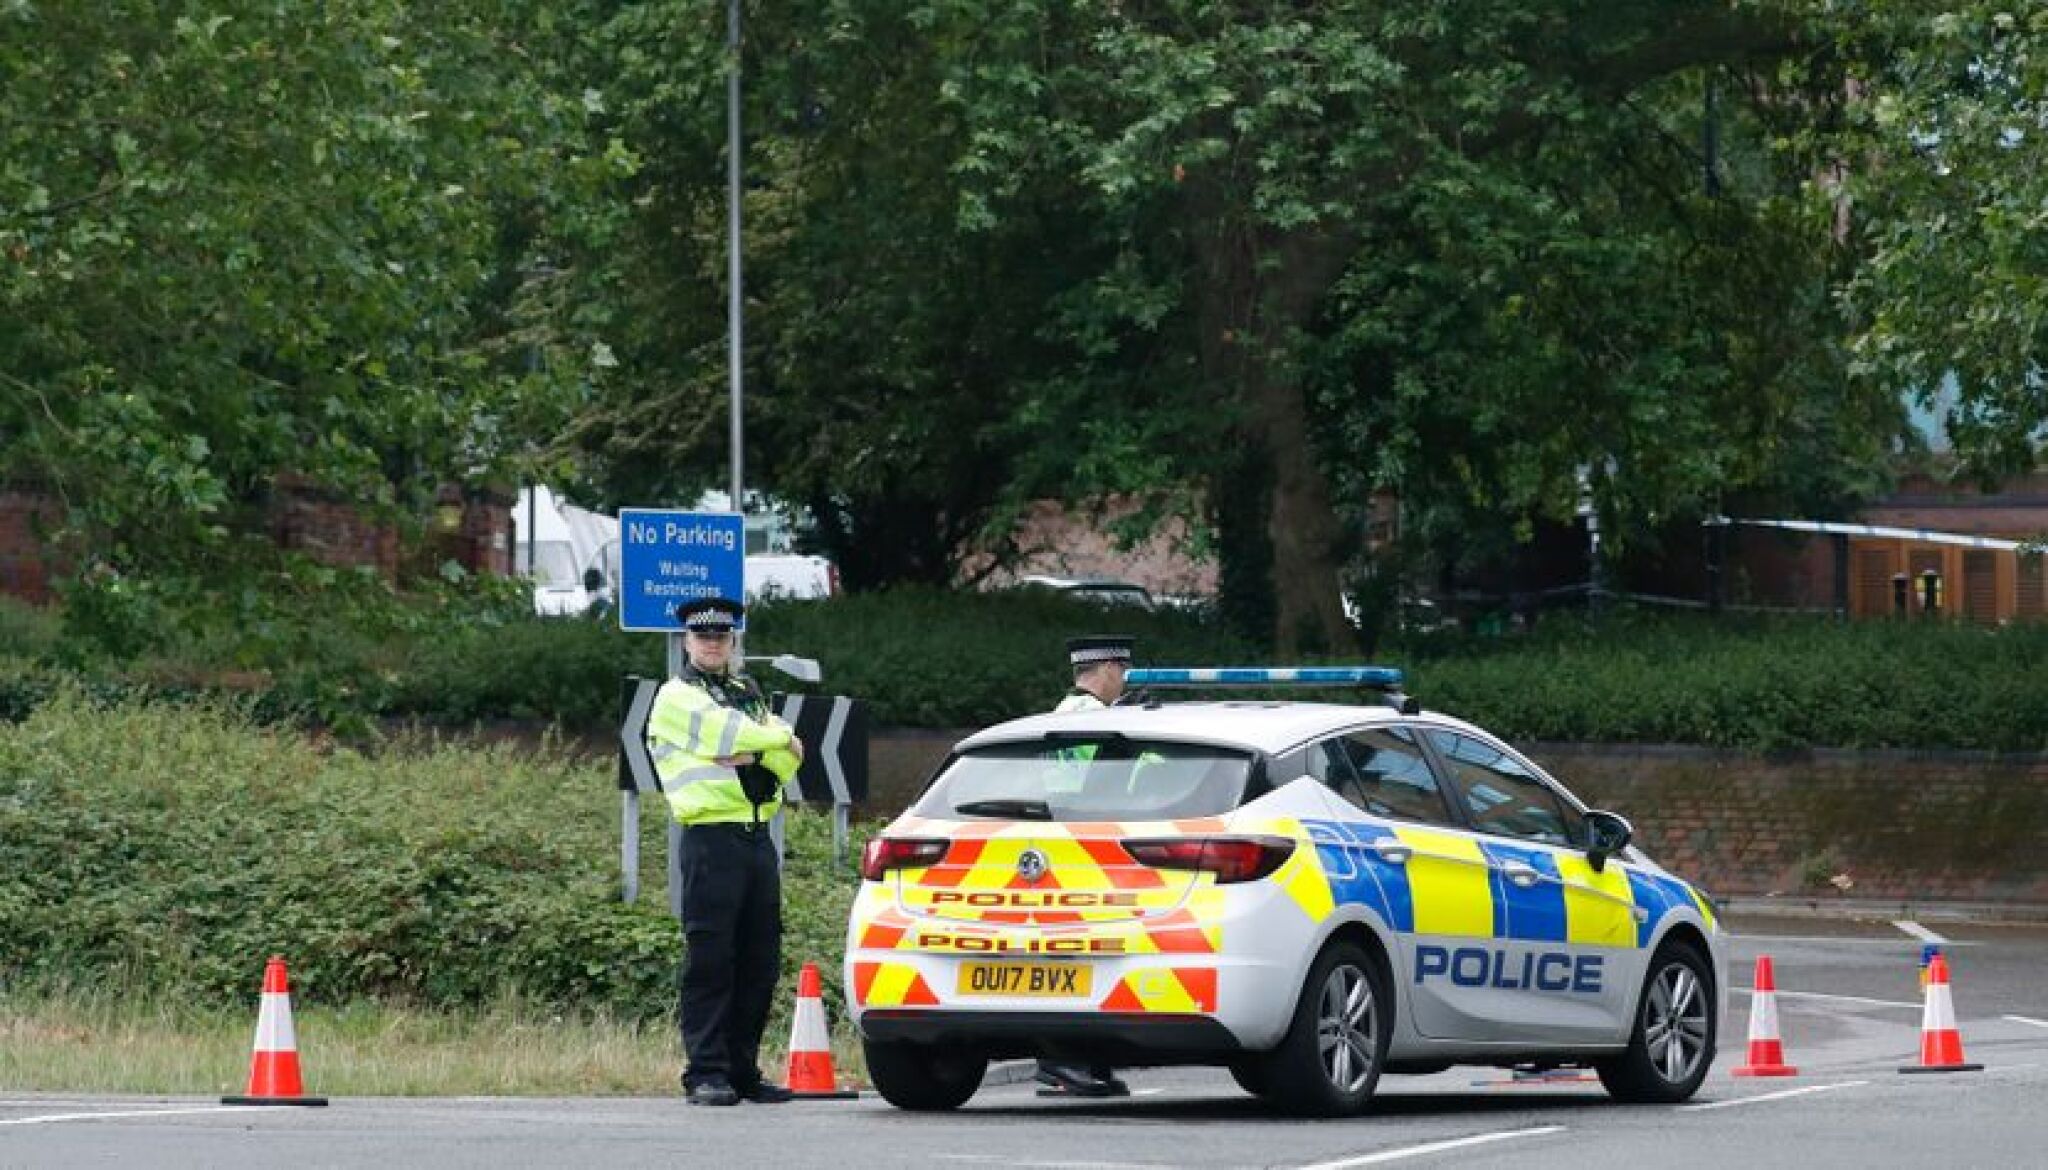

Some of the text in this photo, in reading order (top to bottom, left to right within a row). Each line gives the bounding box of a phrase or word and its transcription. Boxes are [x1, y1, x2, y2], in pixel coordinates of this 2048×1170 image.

[628, 521, 736, 551] No Parking
[659, 559, 709, 581] Waiting
[643, 579, 722, 598] Restrictions
[932, 892, 1138, 907] POLICE
[919, 934, 1126, 952] POLICE
[971, 966, 1077, 992] OU17 BVX
[1415, 944, 1604, 993] POLICE
